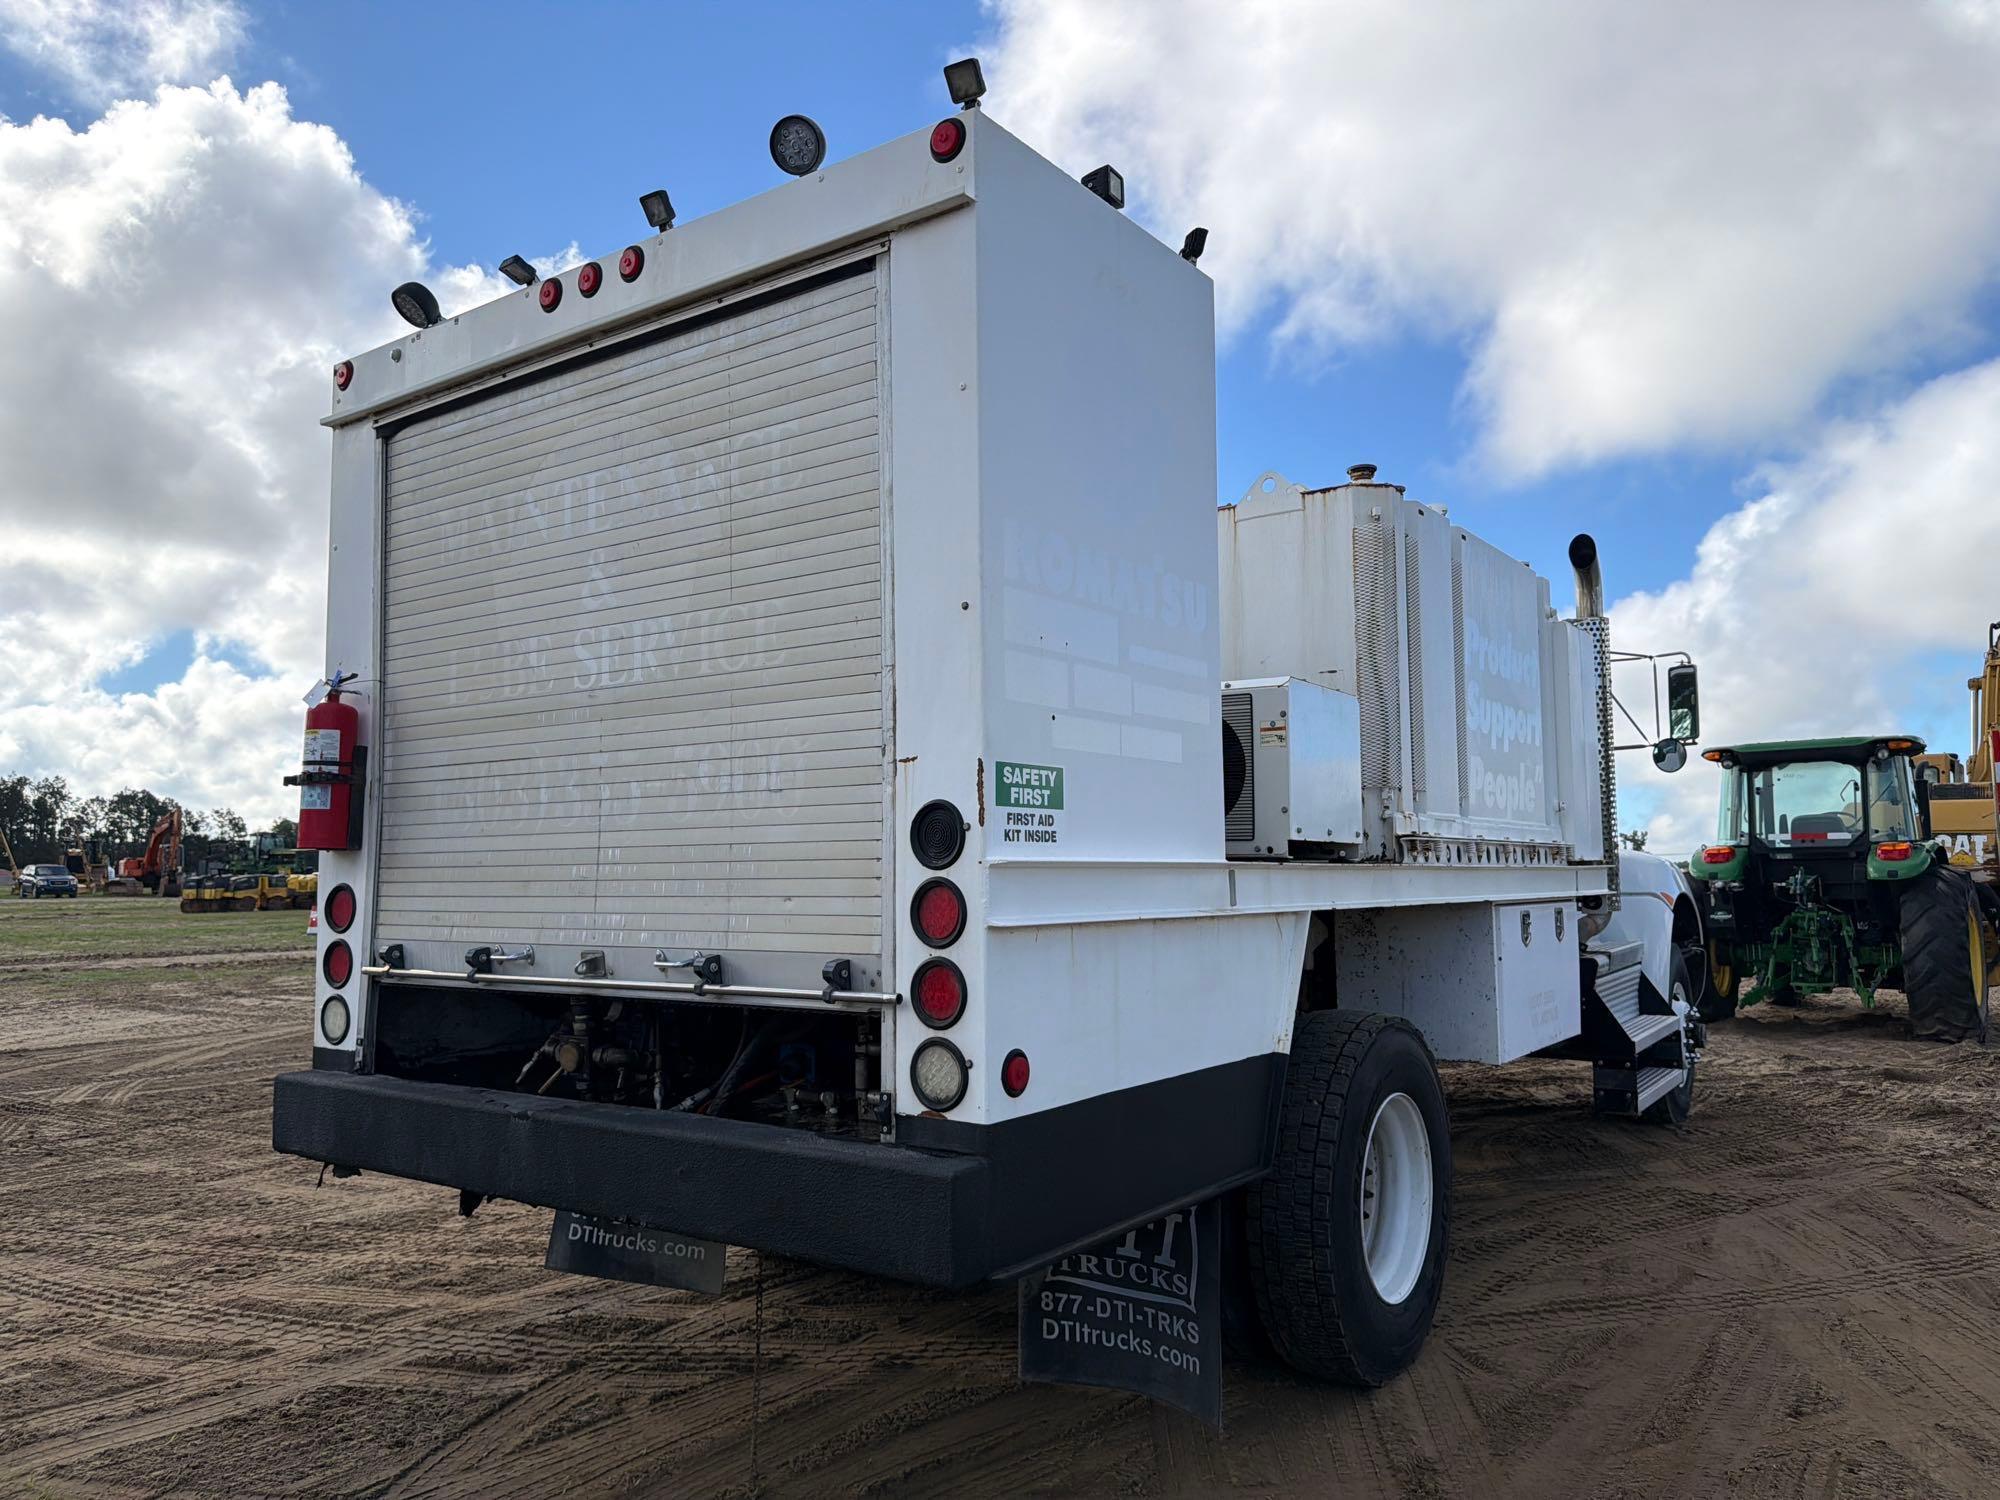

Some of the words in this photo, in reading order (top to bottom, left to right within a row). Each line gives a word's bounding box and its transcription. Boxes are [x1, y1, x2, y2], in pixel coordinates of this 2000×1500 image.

[574, 601, 786, 690] SERVICE
[1003, 766, 1057, 787] SAFETY
[1011, 787, 1051, 806] FIRST
[1004, 829, 1022, 843] KIT
[1024, 829, 1057, 843] INSIDE
[1006, 813, 1035, 826] FIRST
[1037, 813, 1055, 827] AID
[568, 1223, 705, 1260] DTItrucks.com
[1060, 1254, 1189, 1295] TRUCKS
[1040, 1290, 1200, 1345] 877-DTI-TRKS
[1042, 1318, 1200, 1376] DTItrucks.com
